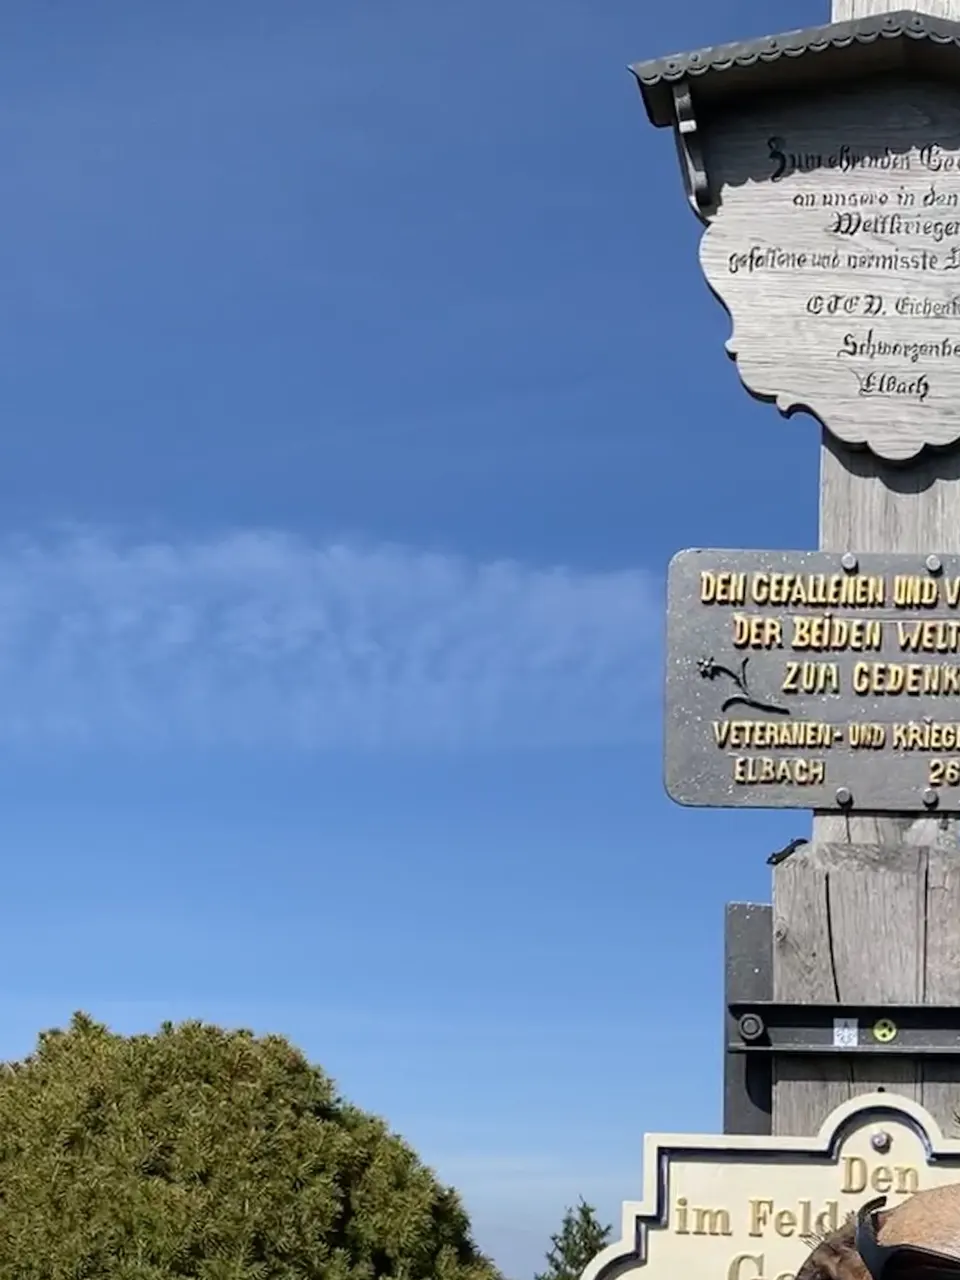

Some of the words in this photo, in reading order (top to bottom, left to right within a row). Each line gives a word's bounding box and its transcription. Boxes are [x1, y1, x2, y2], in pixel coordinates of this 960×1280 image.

[767, 135, 821, 183] Zum
[792, 192, 816, 207] an
[822, 192, 889, 207] unsere
[897, 186, 916, 207] in
[922, 184, 959, 207] den
[728, 246, 808, 274] gefallene
[811, 248, 840, 269] und
[847, 248, 938, 271] vermisste
[857, 370, 930, 402] Elbach
[700, 571, 747, 606] DEN
[752, 572, 885, 608] GEFALLENEN
[893, 575, 939, 610] UND
[732, 612, 784, 650] DER
[792, 612, 883, 652] BEIDEN
[782, 660, 840, 695] ZUM
[848, 722, 886, 751] UND
[734, 756, 827, 786] ELBACH
[840, 1156, 920, 1194] Den
[674, 1197, 733, 1237] im
